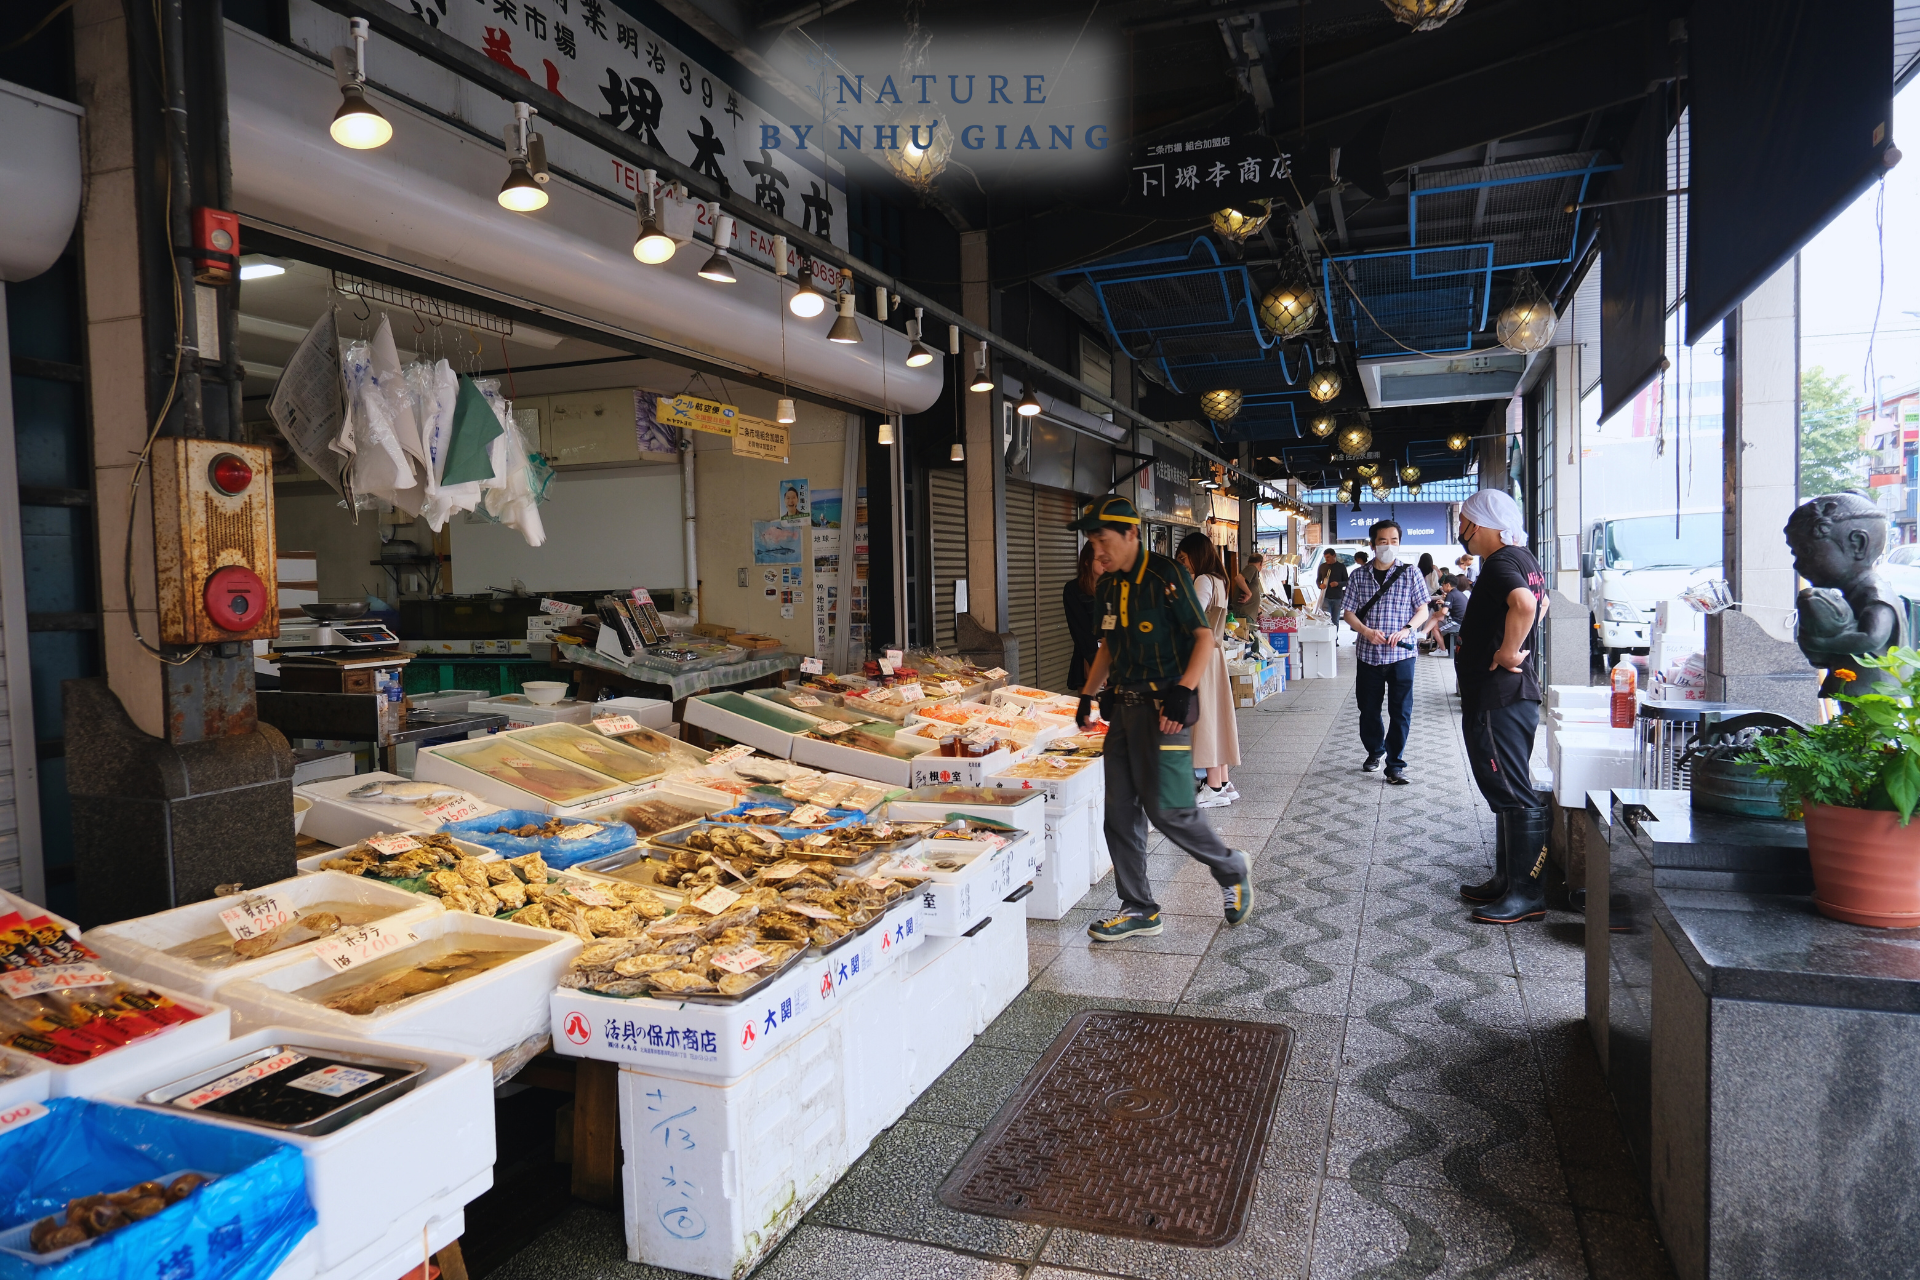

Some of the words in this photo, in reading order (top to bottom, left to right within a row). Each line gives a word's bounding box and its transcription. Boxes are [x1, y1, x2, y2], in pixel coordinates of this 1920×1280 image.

[1185, 136, 1231, 152] 組合加盟店
[813, 534, 841, 543] 地球一
[1407, 527, 1435, 536] Welcome
[1529, 845, 1548, 880] ZACTAS
[254, 911, 288, 932] 250
[895, 917, 914, 945] 大関
[344, 926, 380, 947] ホタテ
[354, 934, 399, 959] 200
[54, 974, 105, 987] 450
[838, 953, 860, 986] 大関
[764, 997, 792, 1036] 大関
[604, 1018, 718, 1053] 活貝の保木商店
[247, 1056, 292, 1077] 200
[663, 1128, 696, 1151] 13
